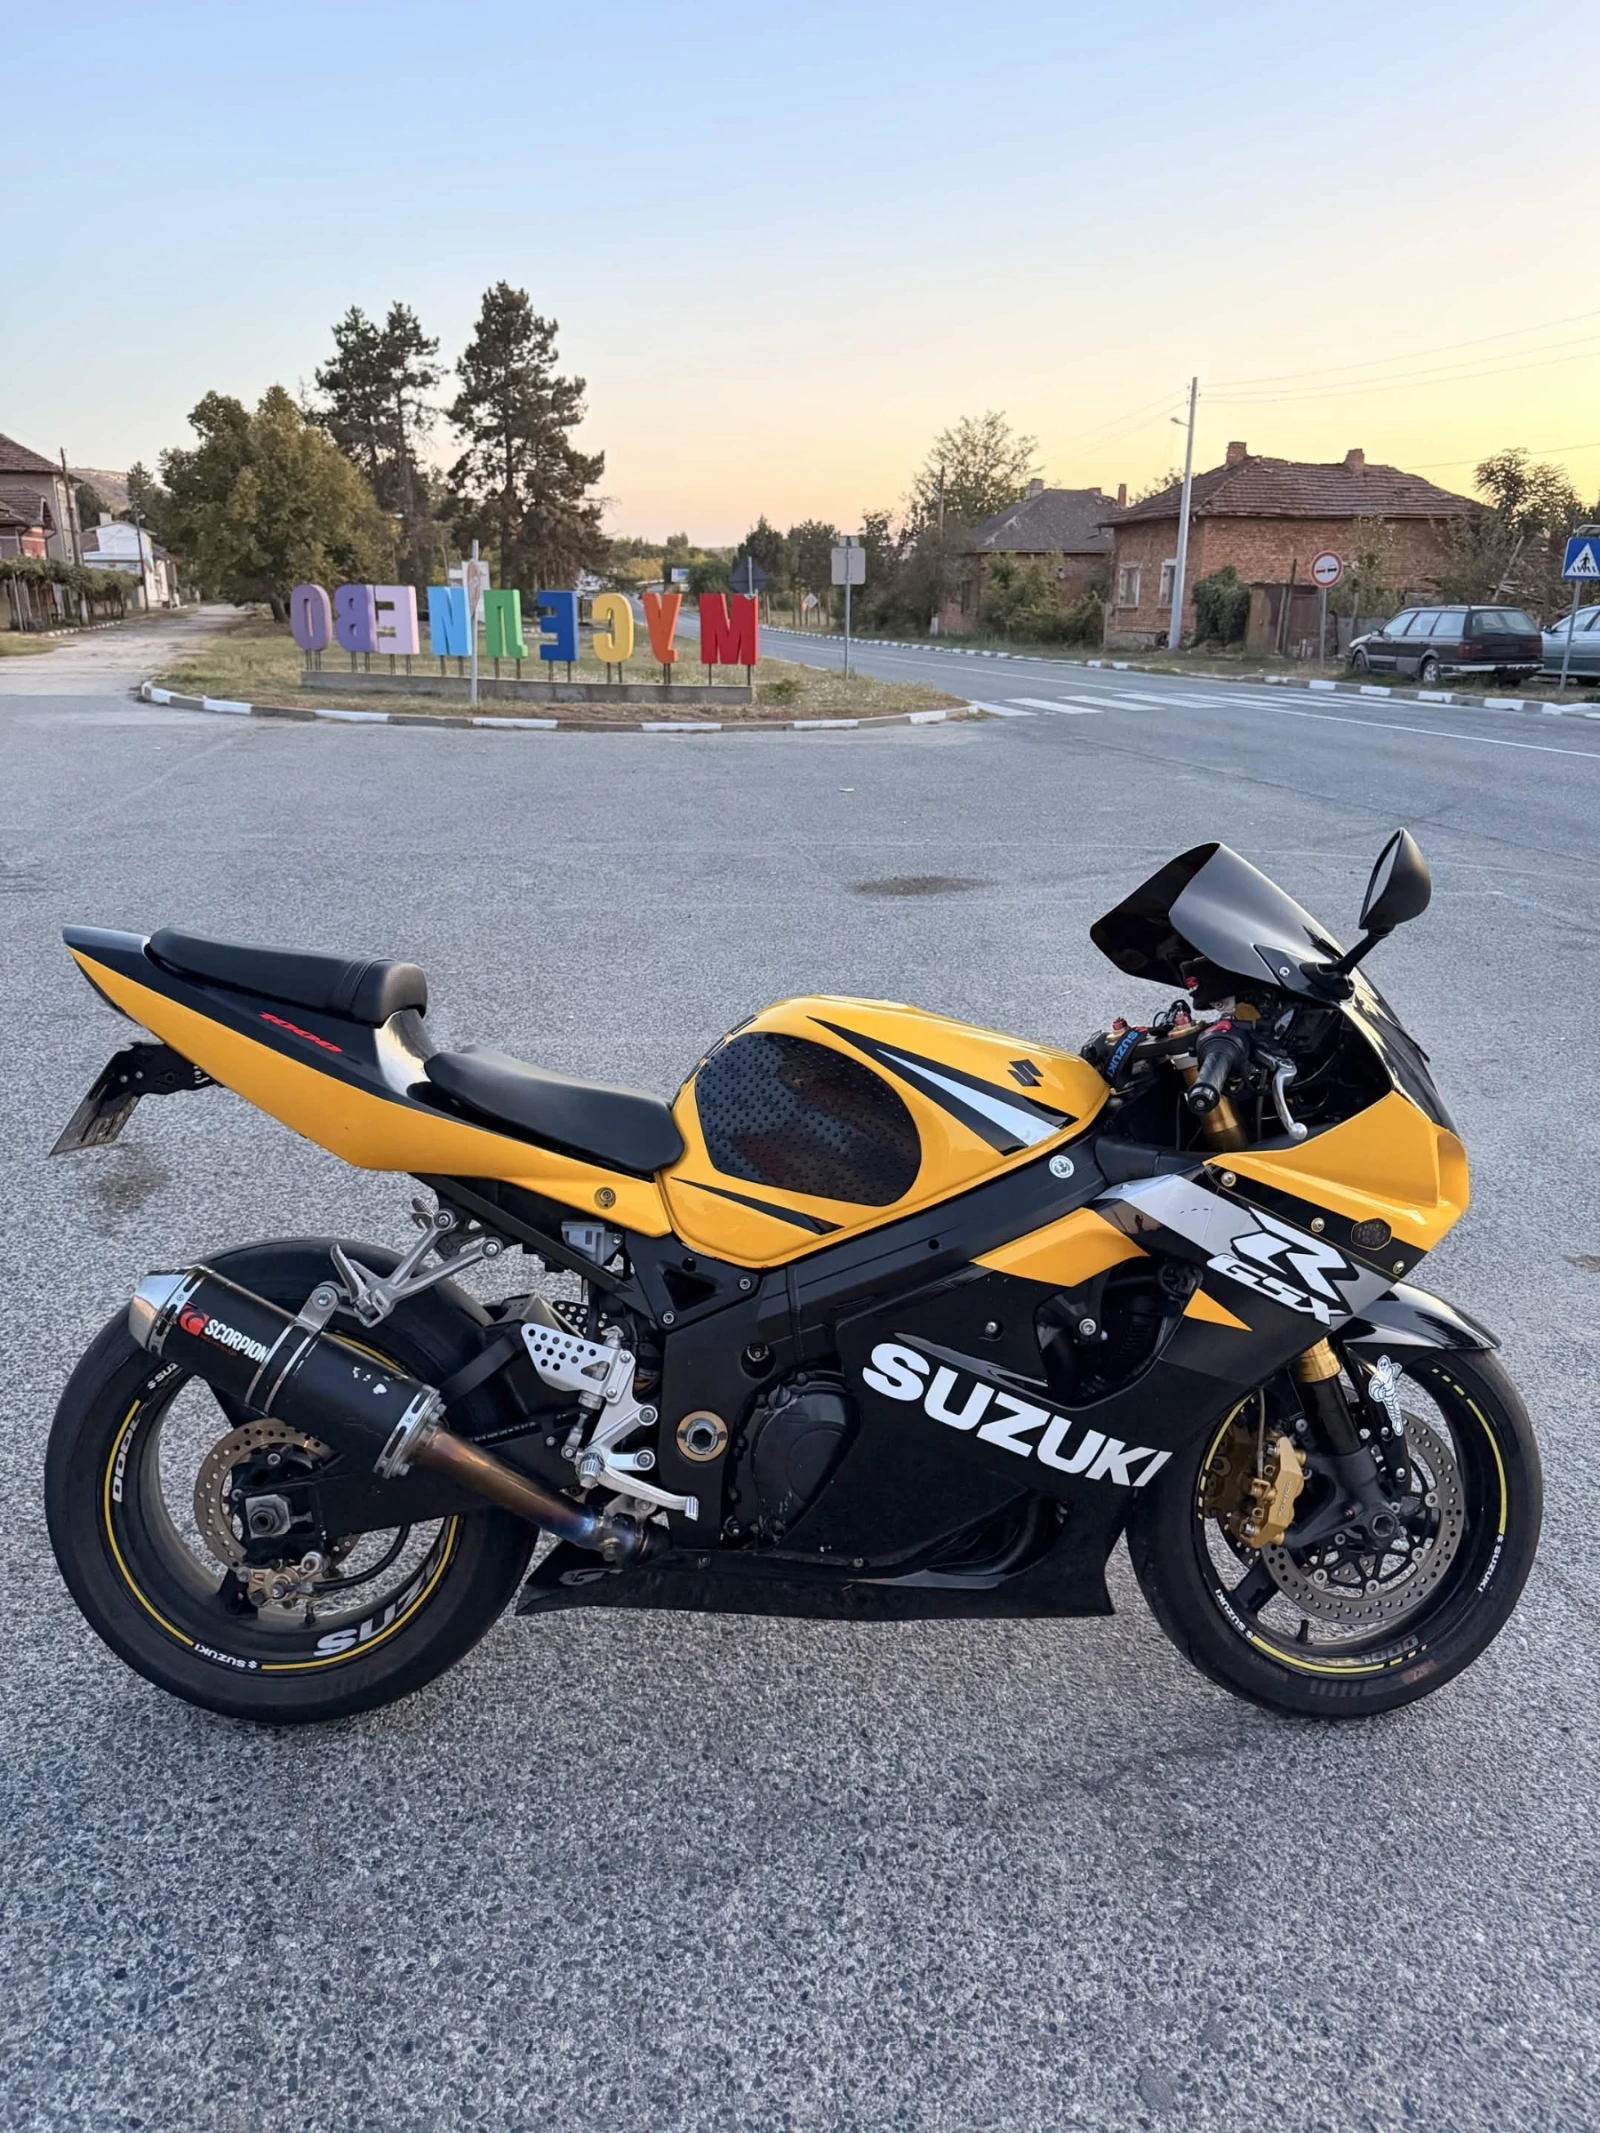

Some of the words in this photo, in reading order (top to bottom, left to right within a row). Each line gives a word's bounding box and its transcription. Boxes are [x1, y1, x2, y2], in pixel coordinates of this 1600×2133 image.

[259, 1011, 342, 1053] 1000
[1107, 1030, 1139, 1077] SUZUKI
[204, 1319, 270, 1363] SCORPION
[863, 1343, 1173, 1486] SUZUKI
[1477, 1545, 1502, 1592] SUZUKI
[1215, 1589, 1246, 1631] SUZUKI
[194, 1644, 247, 1668] SUZUKI
